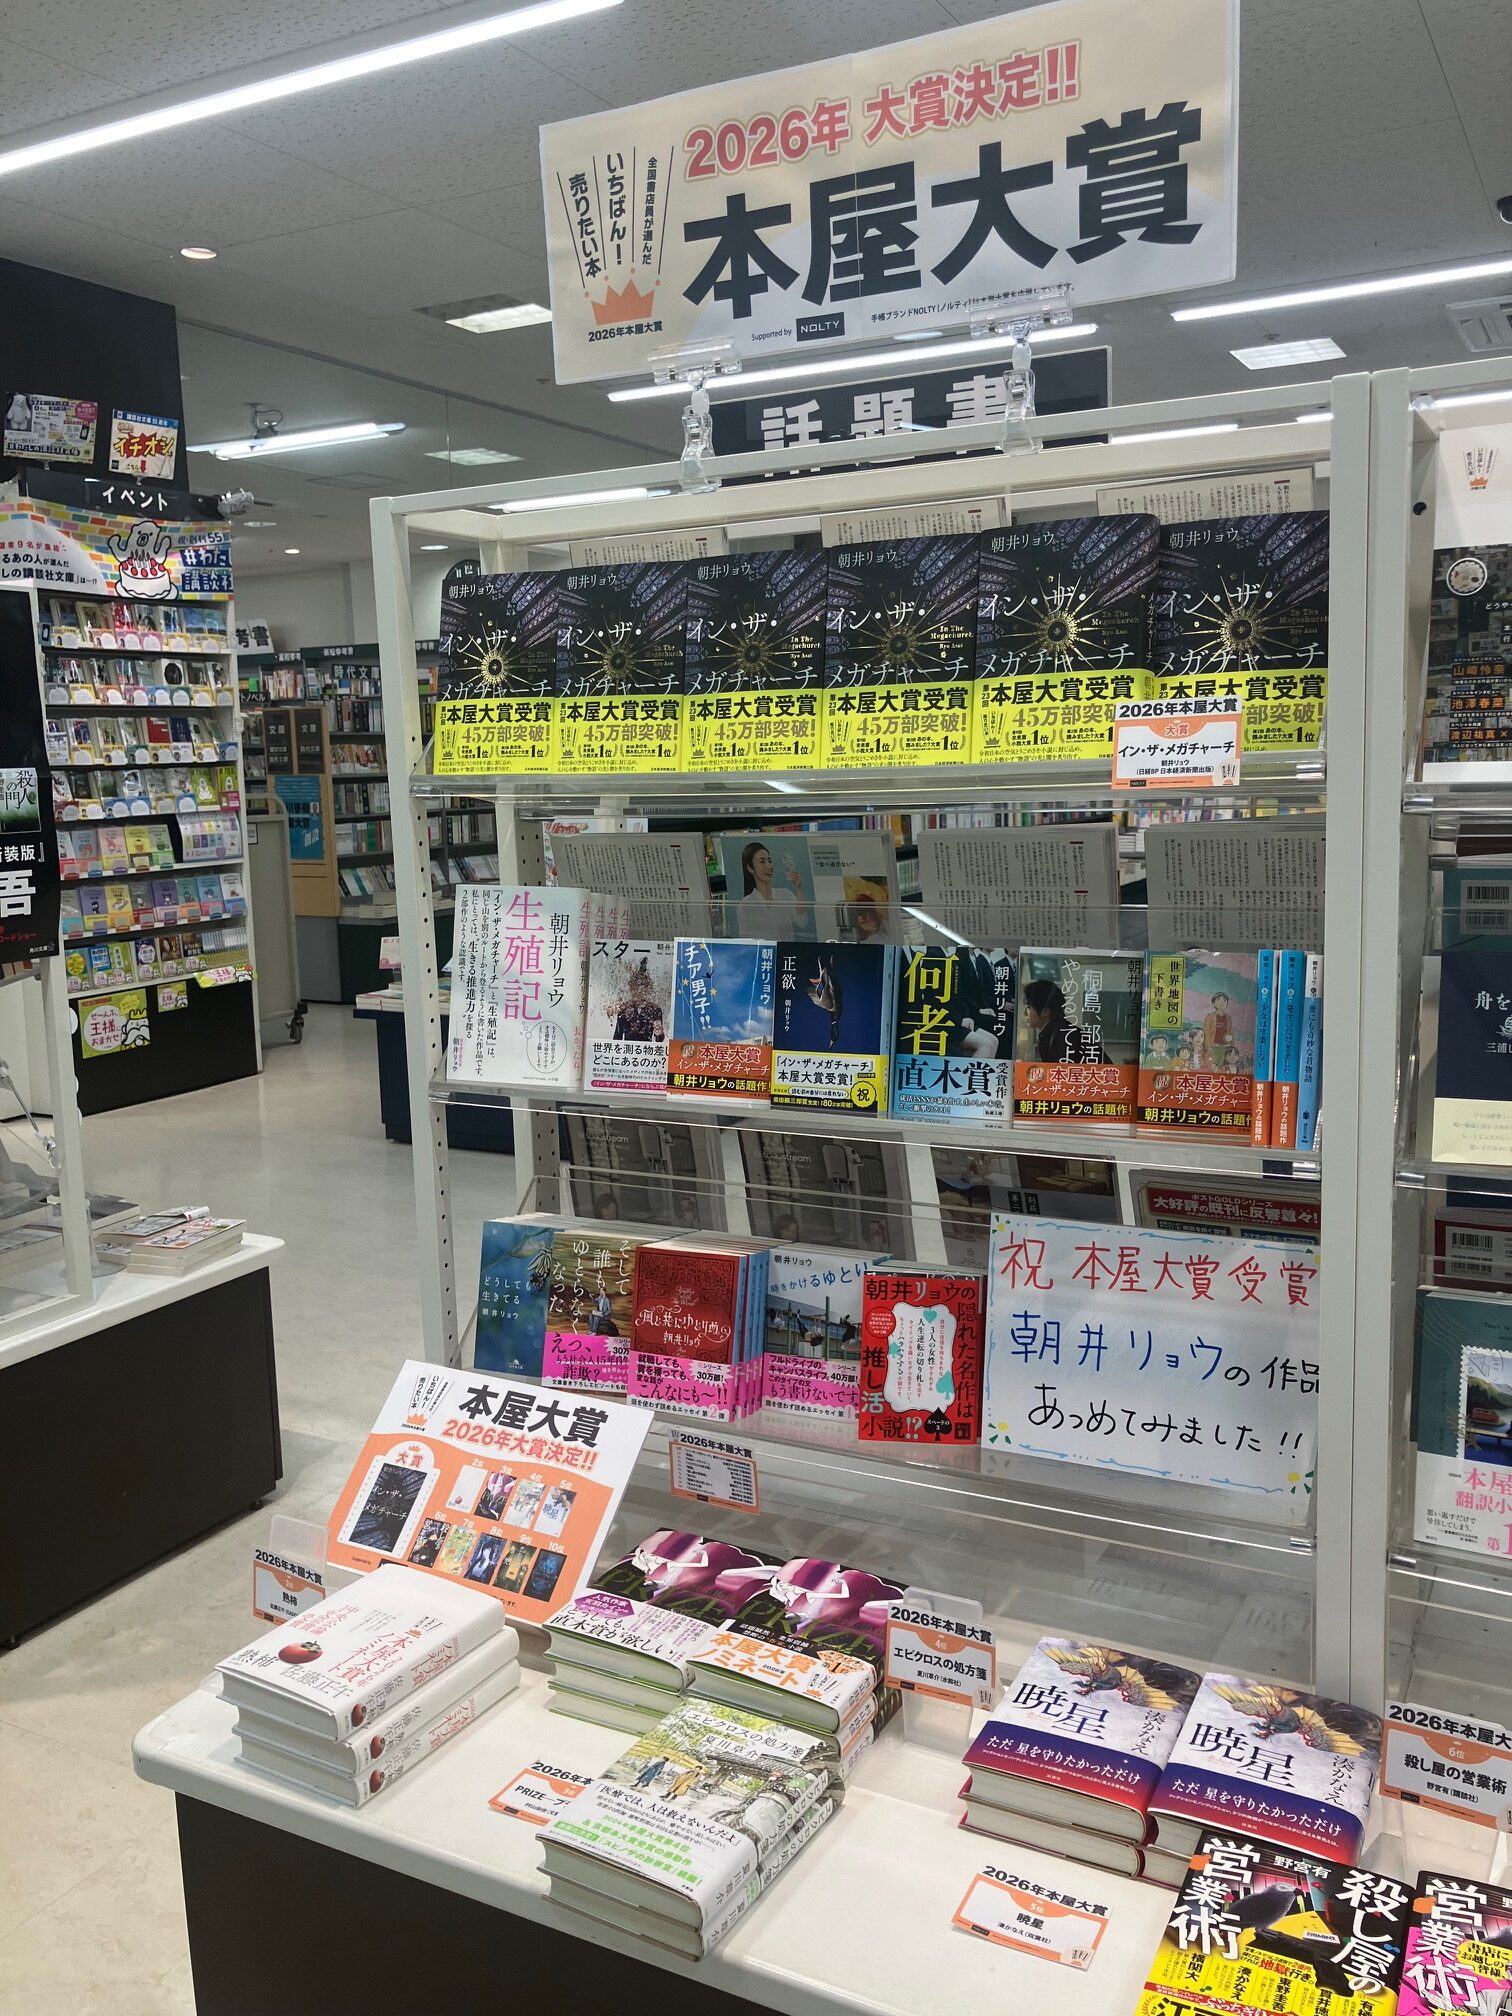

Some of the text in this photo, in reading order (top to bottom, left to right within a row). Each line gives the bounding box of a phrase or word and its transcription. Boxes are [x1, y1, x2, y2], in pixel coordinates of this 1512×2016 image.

[686, 42, 1080, 179] 2026年 大賞決定!!
[606, 153, 627, 265] いちばん!
[642, 157, 658, 265] 全国書店員が選んだ
[682, 102, 1202, 319] 本屋大賞
[569, 172, 602, 279] 売りたい本
[588, 320, 663, 342] 2026年本屋大賞
[751, 328, 793, 343] Supported by
[800, 320, 840, 335] NOLTY
[113, 436, 175, 457] イチオシ
[102, 486, 168, 511] イベント
[991, 531, 1055, 552] 朝井リョウ
[1169, 529, 1239, 549] 朝井リョウ
[464, 564, 473, 575] 12
[697, 563, 751, 580] 朝井リョウ
[838, 550, 896, 568] 朝井リョウ
[449, 583, 494, 599] 朝井リョウ
[567, 575, 616, 590] 朝井リョウ
[1159, 584, 1274, 619] イン・ザ・
[558, 623, 642, 650] イン・ザ・
[334, 665, 380, 679] 時代文庫
[825, 657, 969, 689] メガチャーチ
[976, 644, 1135, 679] メガチャーチ
[558, 674, 680, 698] メガチャーチ
[982, 685, 990, 707] 第23回
[990, 675, 1134, 706] 本屋大賞受賞
[447, 702, 551, 725] 本屋大賞受賞
[566, 700, 680, 724] 本屋大賞受賞
[696, 694, 817, 721] 本屋大賞受賞
[837, 687, 968, 716] 本屋大賞受賞
[1119, 698, 1238, 718] 2026年本屋大賞
[269, 725, 286, 735] 文庫
[462, 725, 550, 743] 45万部突破!
[583, 723, 679, 743] 45万部突破!
[1164, 724, 1189, 736] 大賞
[792, 740, 809, 755] 1位
[1118, 741, 1235, 758] イン・ザ・メガチャーチ
[16, 770, 35, 805] 殺人
[502, 891, 545, 1021] 生殖記
[548, 913, 570, 1008] 朝井リョウ
[592, 941, 651, 959] スター
[781, 955, 797, 990] 正欲
[900, 951, 959, 1056] 何者
[993, 966, 1009, 1036] 朝井リョウ
[1153, 973, 1166, 1011] 下書き
[1167, 961, 1181, 1025] 世界地図の
[1475, 990, 1510, 1010] 舟を
[1058, 958, 1080, 1064] やめるってよ
[1080, 969, 1102, 1064] 桐島、部活
[1304, 1005, 1317, 1083] 世にも奇妙な君物語
[593, 1055, 665, 1068] どこにあるのか?
[776, 1056, 873, 1072] 『イン・ザ・メガチャーチ』
[673, 1074, 771, 1092] 朝井リョウの話題作!
[778, 1071, 853, 1086] 本屋大賞受賞!
[898, 1058, 996, 1097] 直木賞
[995, 1062, 1008, 1099] 受賞作
[1049, 1066, 1119, 1085] 本屋大賞
[857, 1088, 870, 1101] 祝
[1019, 1100, 1133, 1116] 朝井リョウの話題作!
[1255, 1083, 1264, 1141] 朝井リョウの話題作
[1280, 1086, 1289, 1144] 朝井リョウの話題作
[1192, 1194, 1273, 1208] ポストGOLDシリーズ
[593, 1248, 610, 1288] 誰も
[617, 1239, 630, 1295] そして
[999, 1232, 1054, 1290] 祝
[484, 1276, 531, 1291] どうしても
[549, 1261, 566, 1312] なった
[570, 1239, 589, 1335] ゆとらなく
[865, 1278, 976, 1302] 朝井リョウの
[482, 1290, 520, 1305] 生きてる
[551, 1332, 592, 1354] えっ、
[637, 1353, 683, 1368] 就職しても、
[770, 1355, 821, 1369] フルドライブの
[955, 1303, 977, 1418] 隠れた名作は
[696, 1371, 724, 1382] 30万部!
[831, 1373, 858, 1383] 40万部!
[861, 1345, 886, 1413] 推し活
[459, 1384, 609, 1448] 本屋大賞
[862, 1415, 923, 1439] 小説!?
[441, 1419, 599, 1472] 2026年大賞決定!!
[395, 1451, 422, 1468] 大賞
[1464, 1467, 1512, 1496] 本屋
[1456, 1491, 1512, 1514] 翻訳小
[1426, 1517, 1472, 1532] 号泣してしまう。
[1427, 1509, 1477, 1524] 思い返すだけで
[1488, 1536, 1500, 1551] 第
[891, 1606, 992, 1644] 2026年本屋大賞
[231, 1648, 278, 1667] 熟柿
[327, 1632, 395, 1673] ノミネート
[710, 1633, 817, 1673] 本屋大賞
[935, 1639, 947, 1650] 4位
[692, 1648, 799, 1688] ノミネート
[762, 1664, 786, 1675] 2026年
[894, 1647, 987, 1681] エピクロスの処方箋
[278, 1664, 355, 1699] 佐藤正午
[1011, 1682, 1109, 1741] 暁星
[687, 1711, 807, 1759] エピクロスの処方箋
[1131, 1710, 1165, 1755] 湊かなえ
[1389, 1705, 1512, 1750] 2026年本屋大
[703, 1735, 759, 1759] 夏川草介
[986, 1735, 1141, 1784] ただ 星を守りたかっただけ
[1188, 1722, 1296, 1789] 暁星
[1448, 1747, 1465, 1760] 6位
[1325, 1755, 1356, 1807] 湊かなえ
[1405, 1753, 1507, 1795] 殺し屋の営業術
[1172, 1778, 1342, 1837] ただ 星を守りたかっただけ
[1273, 1855, 1333, 1880] 野宮有
[982, 1865, 1109, 1917] 2026年本屋大賞
[1168, 1837, 1261, 1961] 営業術
[1016, 1912, 1045, 1930] 暁星
[1330, 1869, 1411, 1995] 殺し屋の
[1405, 1879, 1487, 2008] 営業術
[1184, 1952, 1205, 1982] 横関大
[1271, 1976, 1292, 2013] 東野圭吾
